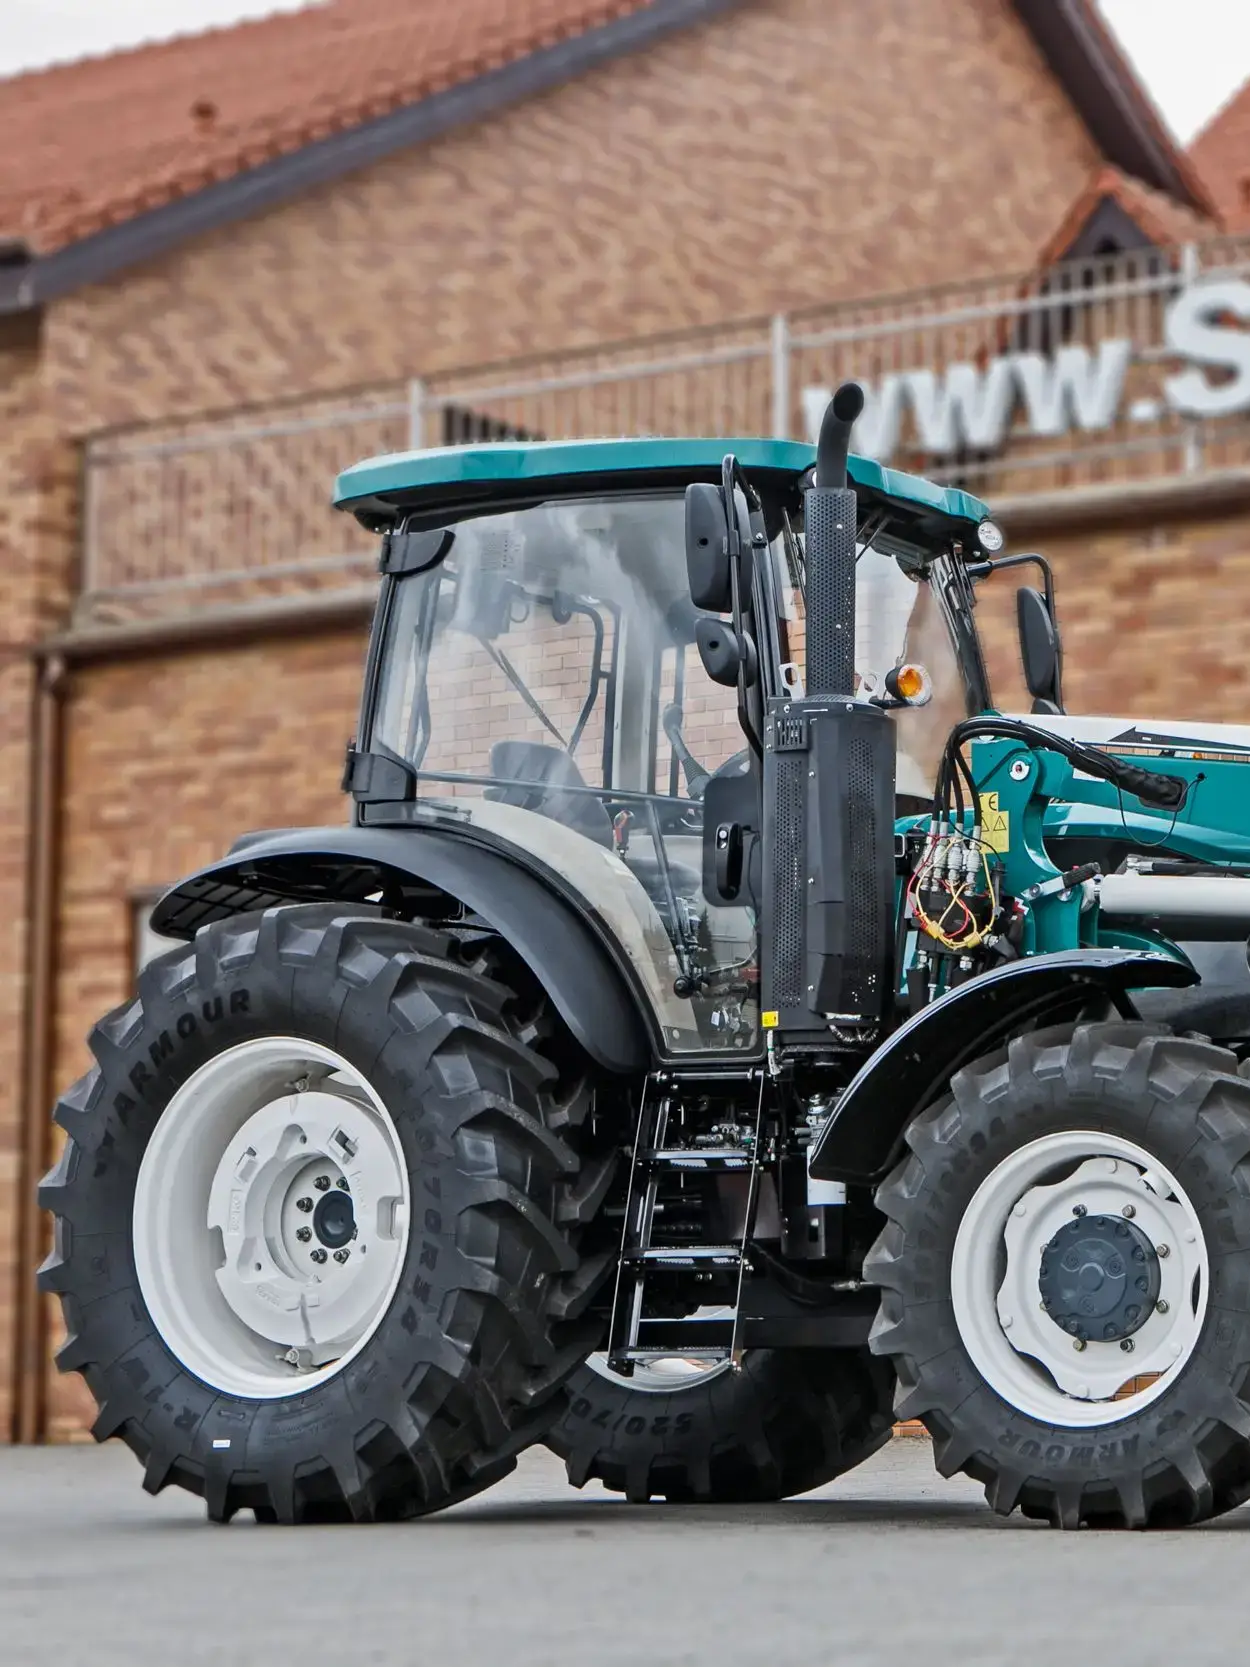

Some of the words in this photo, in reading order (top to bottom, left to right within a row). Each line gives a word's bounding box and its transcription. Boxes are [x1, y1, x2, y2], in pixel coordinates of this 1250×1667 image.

[112, 988, 250, 1127] ARMOUR
[570, 1397, 694, 1436] 520/70
[998, 1428, 1141, 1468] ARMOUR
